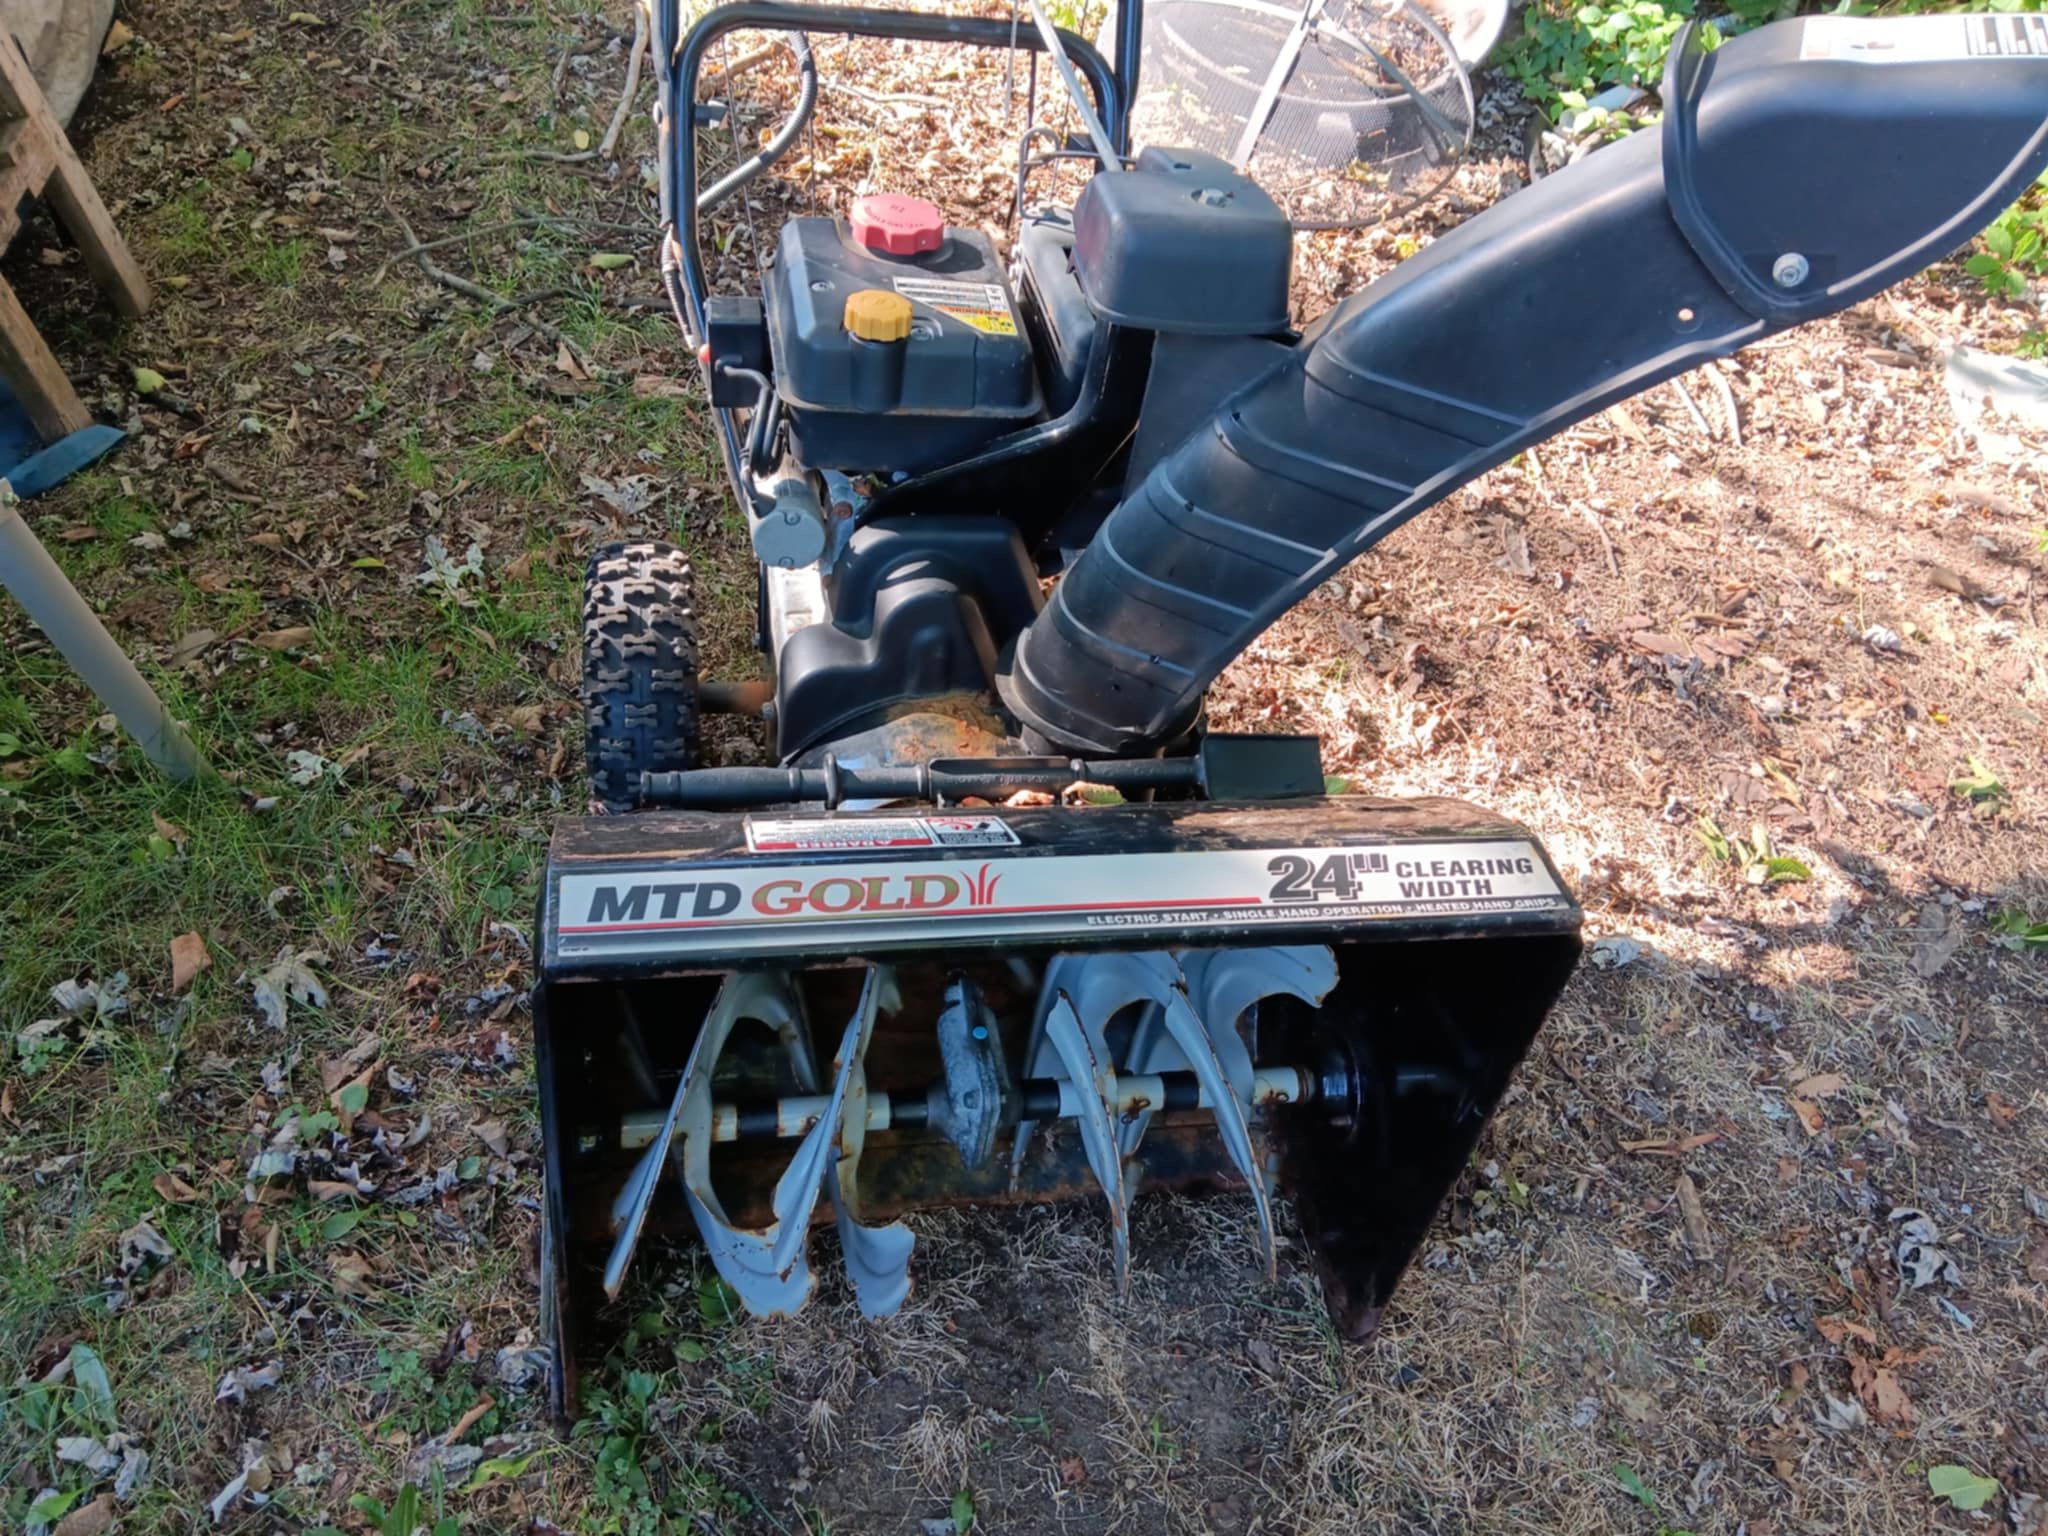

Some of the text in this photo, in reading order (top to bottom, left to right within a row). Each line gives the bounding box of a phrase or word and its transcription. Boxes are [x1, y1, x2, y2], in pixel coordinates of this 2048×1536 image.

[1395, 857, 1535, 879] CLEARING
[587, 874, 961, 922] MTD GOLD
[1399, 878, 1493, 898] WIDTH
[1087, 897, 1557, 926] ELECTRIC START SINGLE HAND OPERATION HEATED HAND GRIPS
